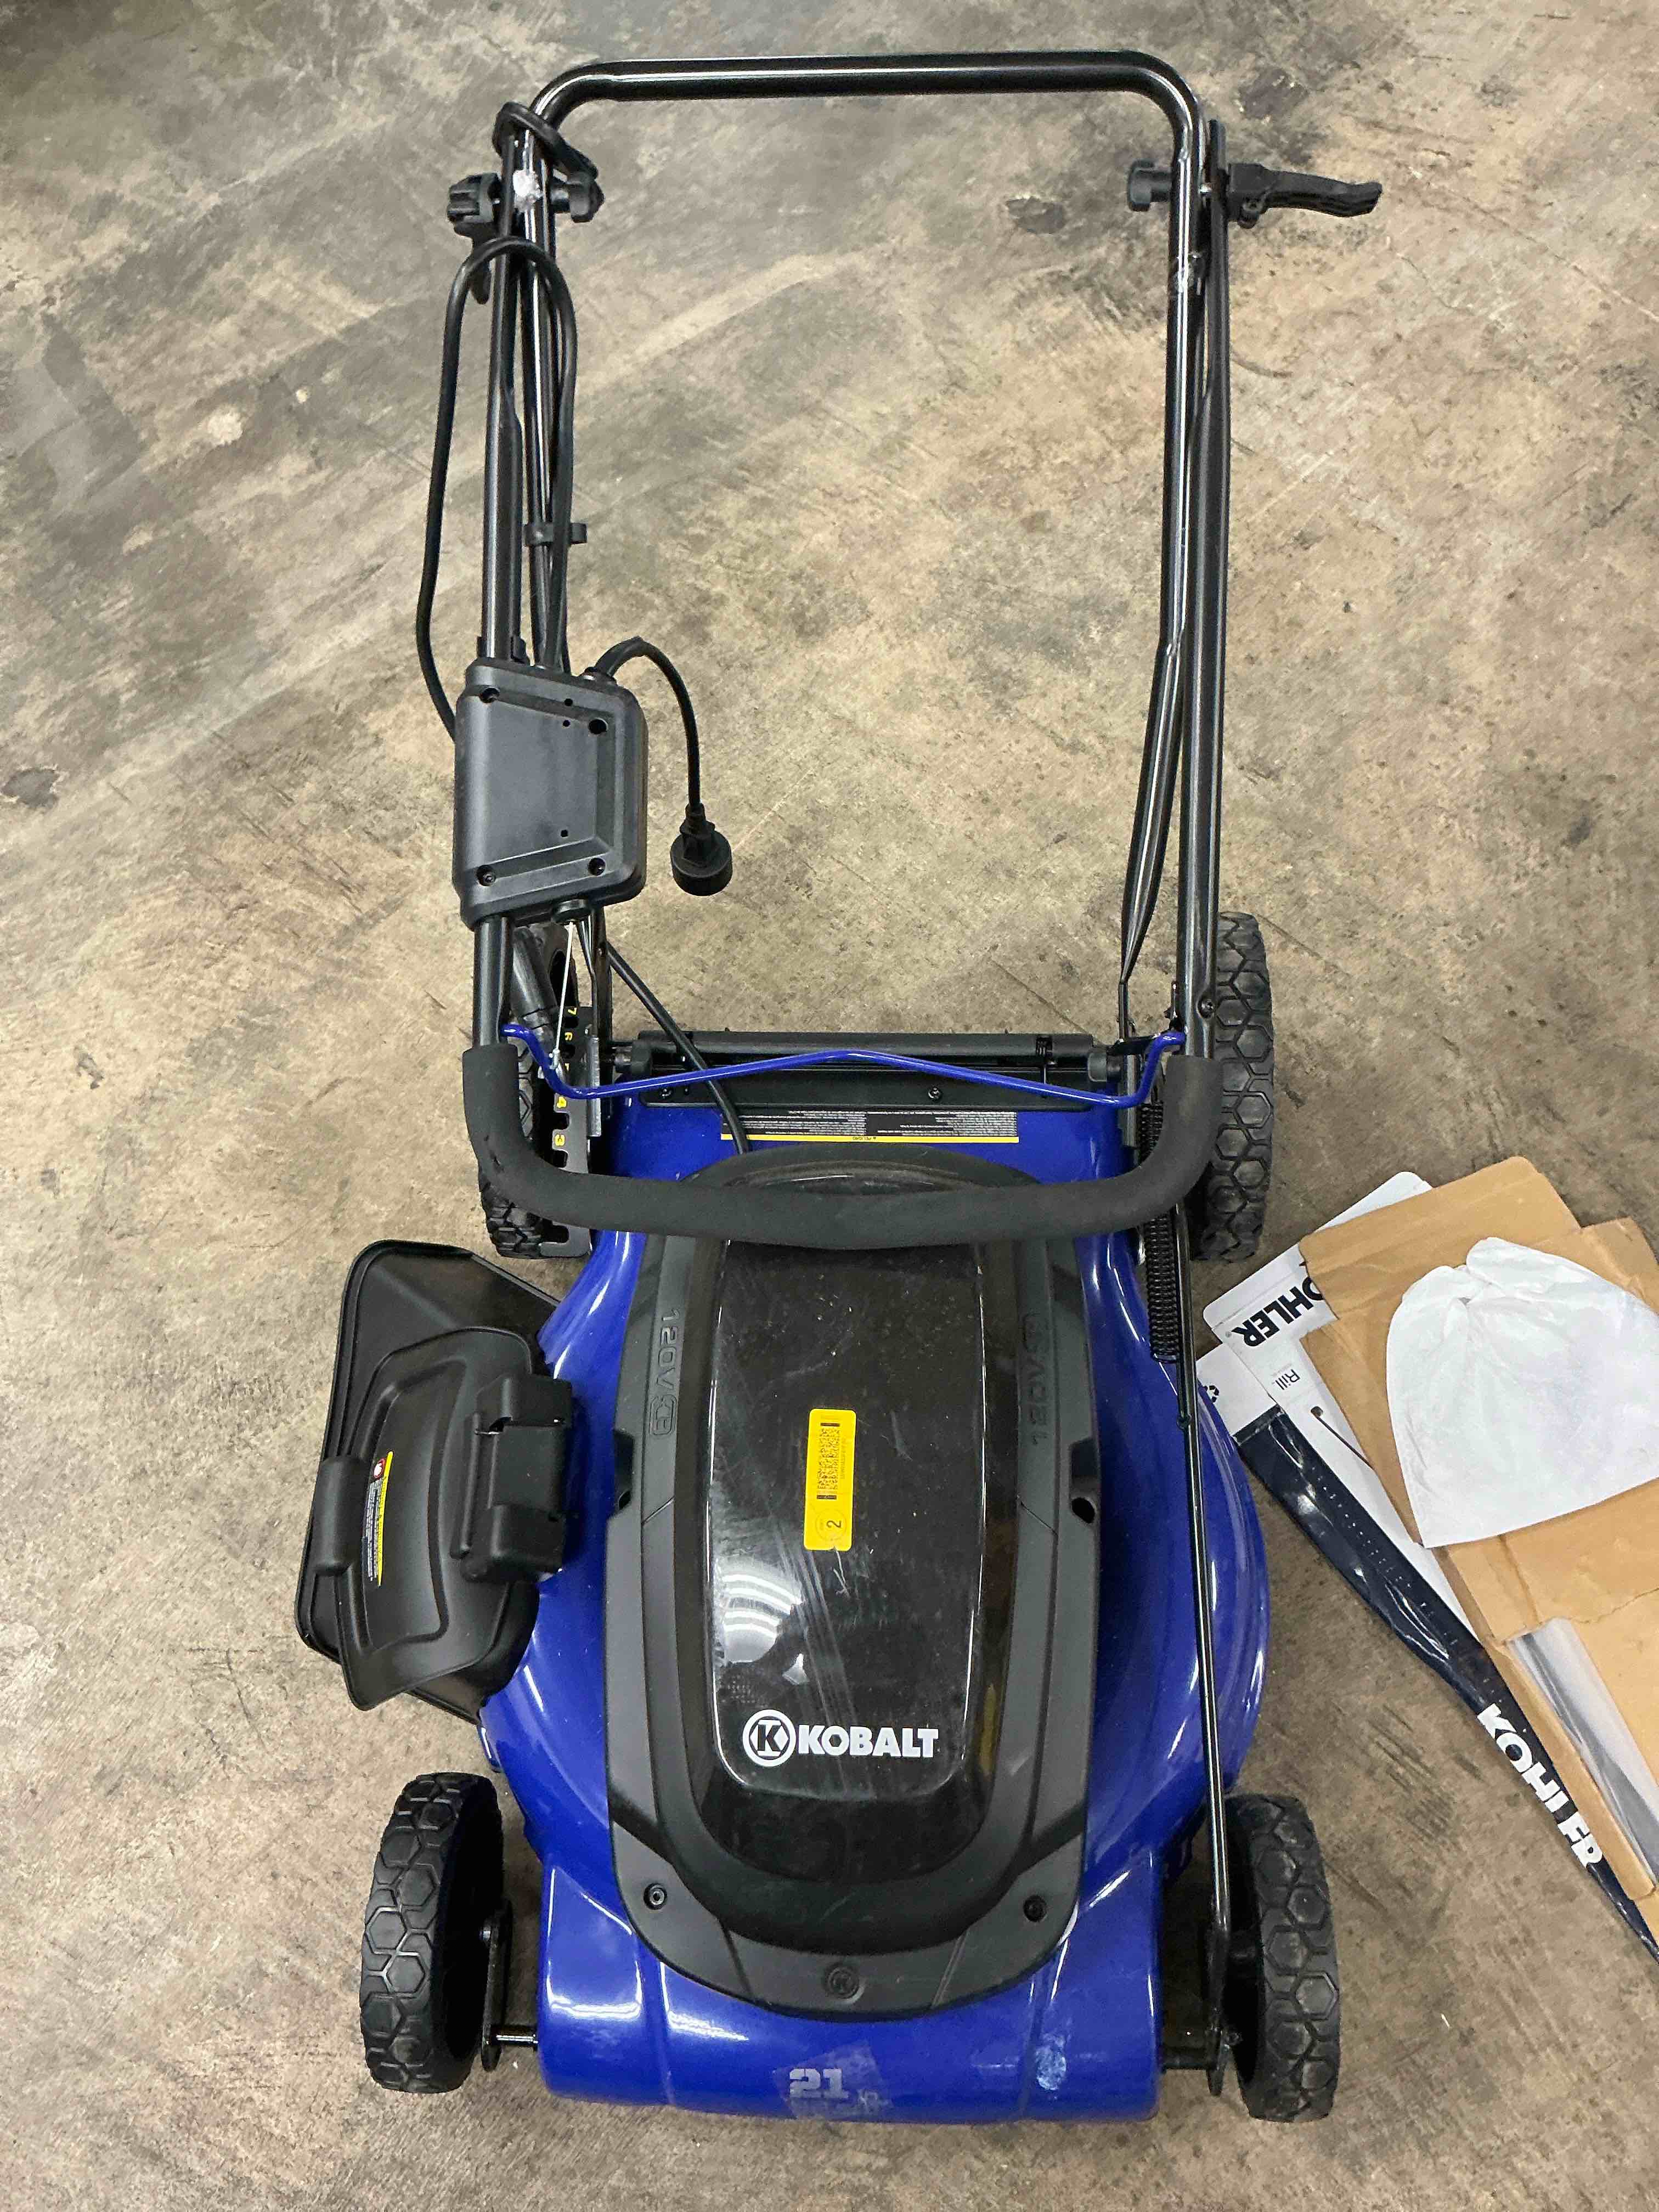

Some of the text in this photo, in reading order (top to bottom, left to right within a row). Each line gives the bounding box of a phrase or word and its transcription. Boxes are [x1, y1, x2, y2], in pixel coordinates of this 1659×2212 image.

[567, 1007, 577, 1015] 7
[657, 1308, 680, 1389] 120V
[827, 1519, 842, 1529] 2
[798, 1724, 939, 1758] KOBALT
[789, 2067, 849, 2098] 21
